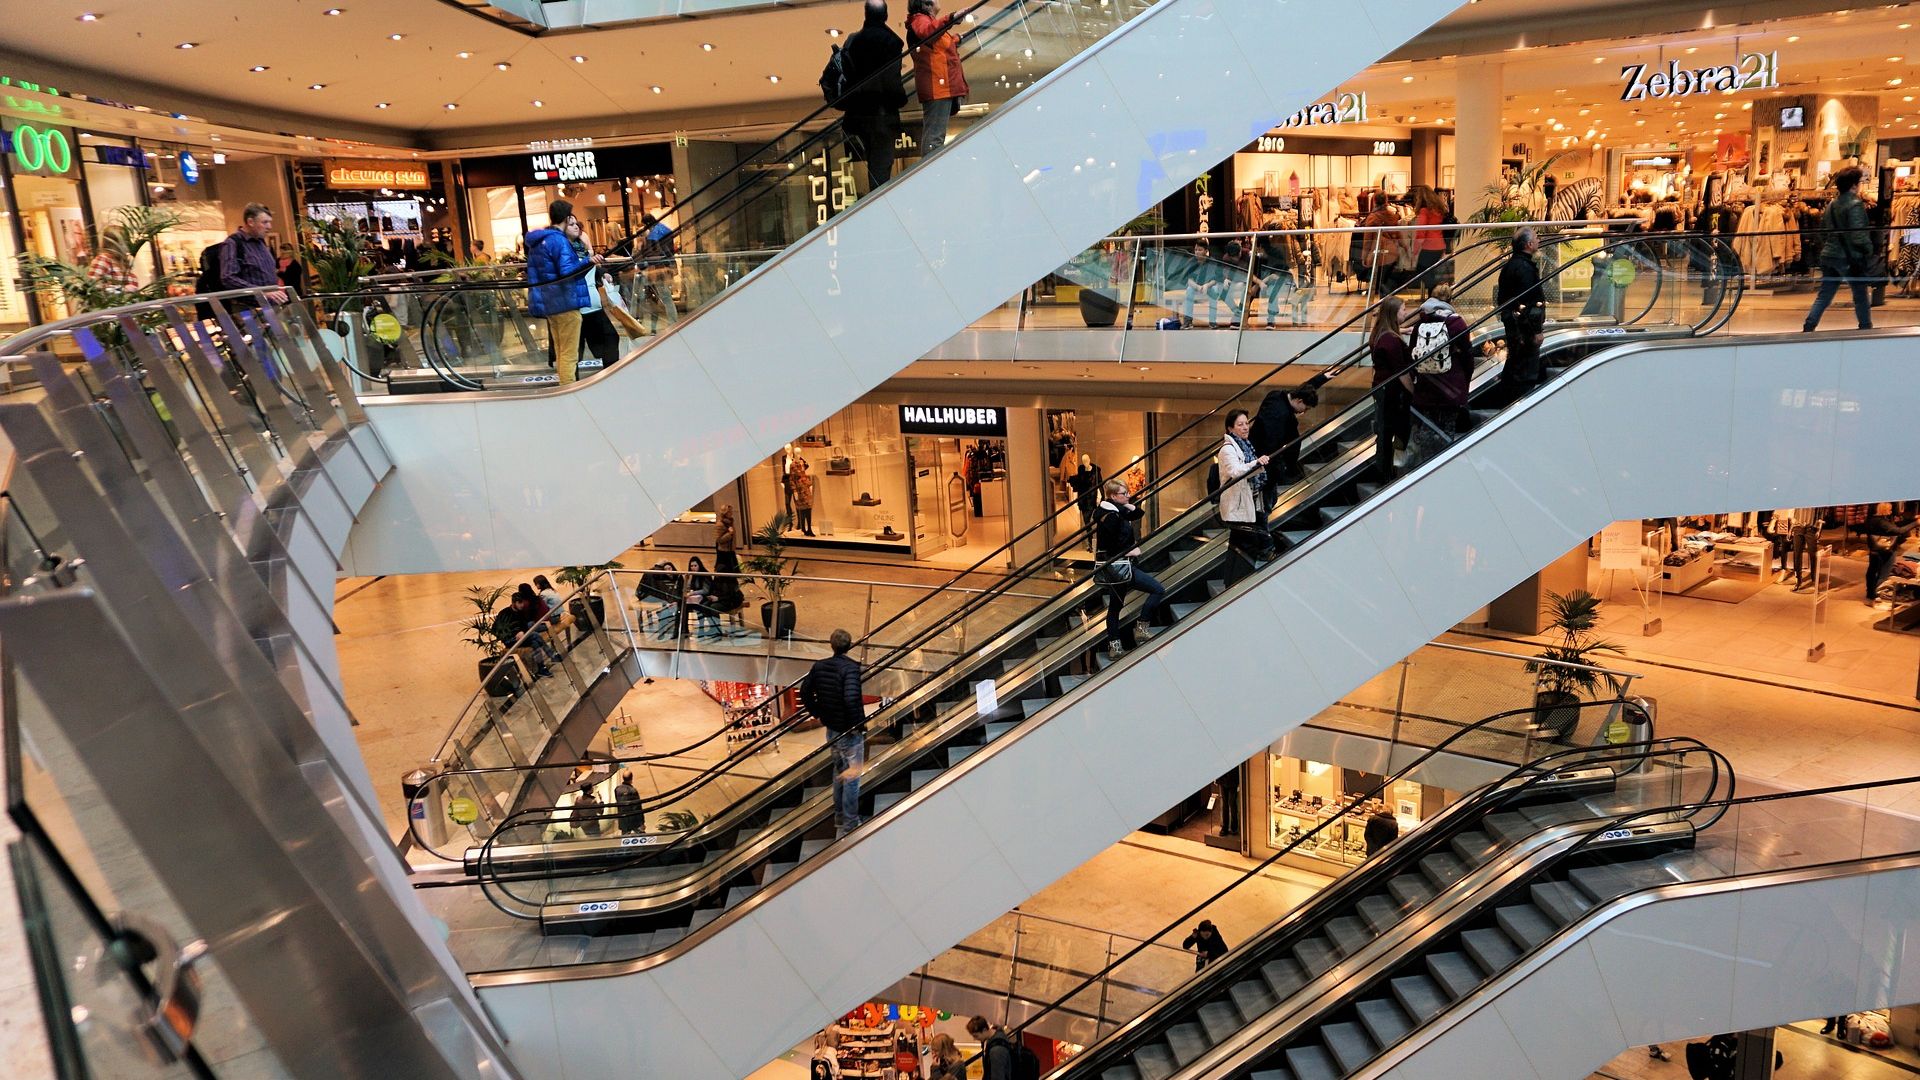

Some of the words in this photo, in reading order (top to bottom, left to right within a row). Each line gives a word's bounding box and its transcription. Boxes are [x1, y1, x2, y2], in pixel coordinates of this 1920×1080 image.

[1620, 50, 1779, 102] Zebra21
[1257, 136, 1285, 153] zero
[1373, 141, 1396, 156] zero
[532, 151, 595, 171] HILFIGER
[559, 165, 598, 181] DENIM
[904, 406, 997, 425] HALLHUBER
